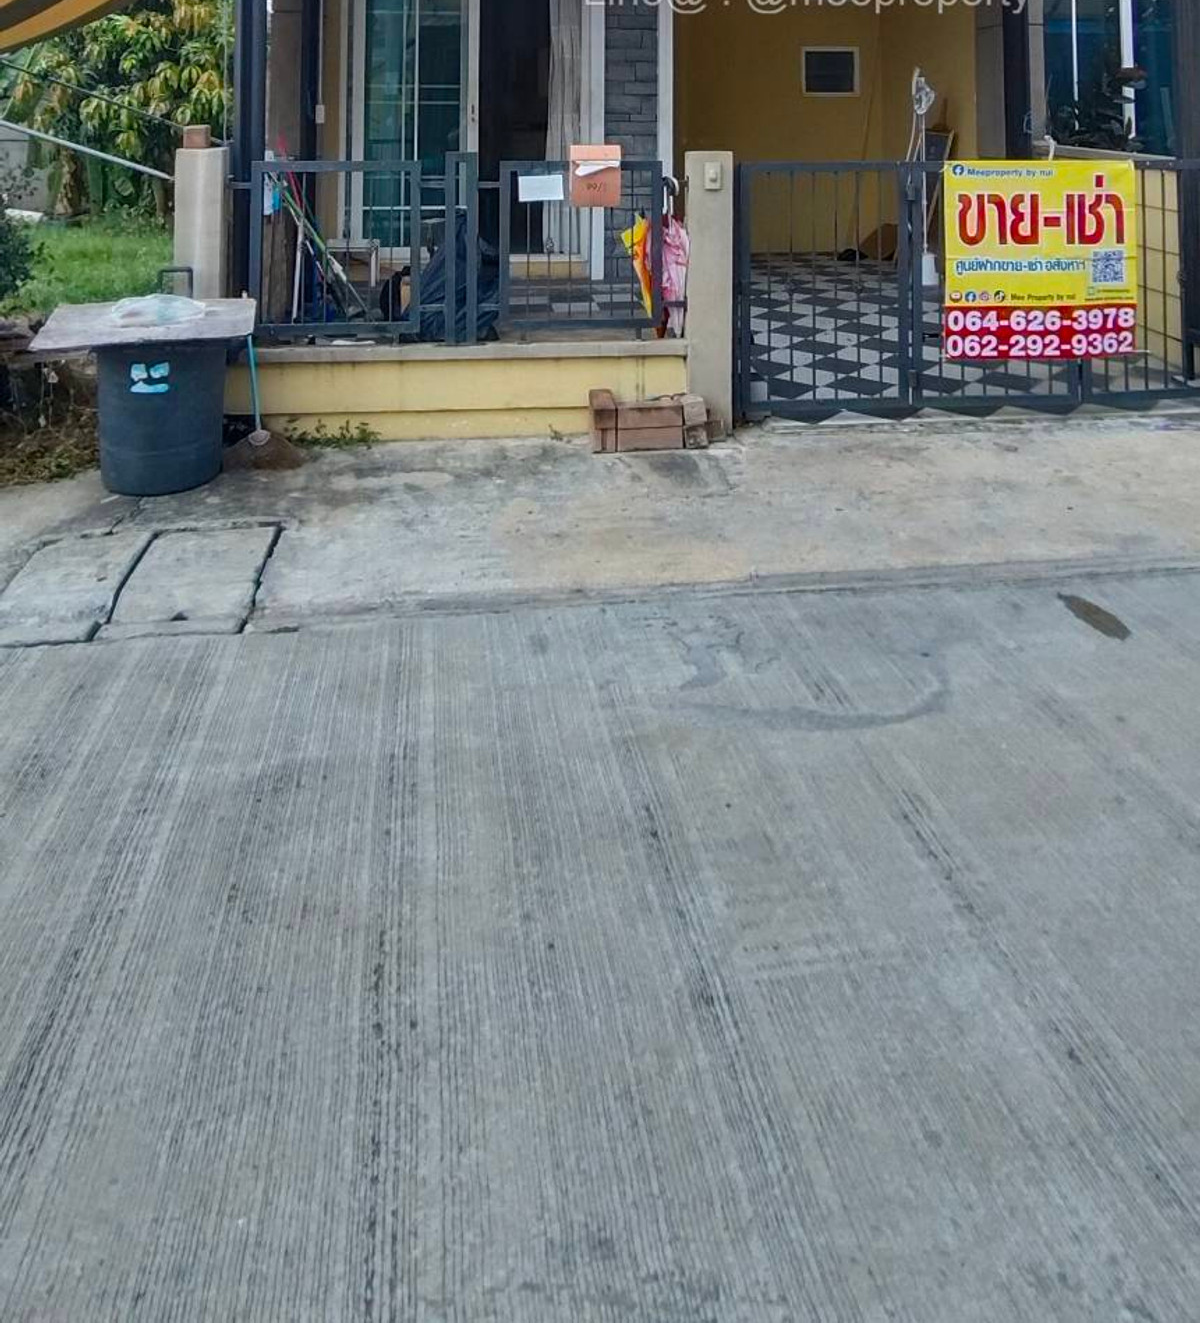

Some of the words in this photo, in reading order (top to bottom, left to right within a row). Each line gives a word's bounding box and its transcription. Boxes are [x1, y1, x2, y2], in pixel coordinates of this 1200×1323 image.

[957, 175, 1125, 246] ขาย-เช่า
[947, 308, 1135, 332] 064-626-3978
[946, 332, 1133, 357] 062-292-9362
